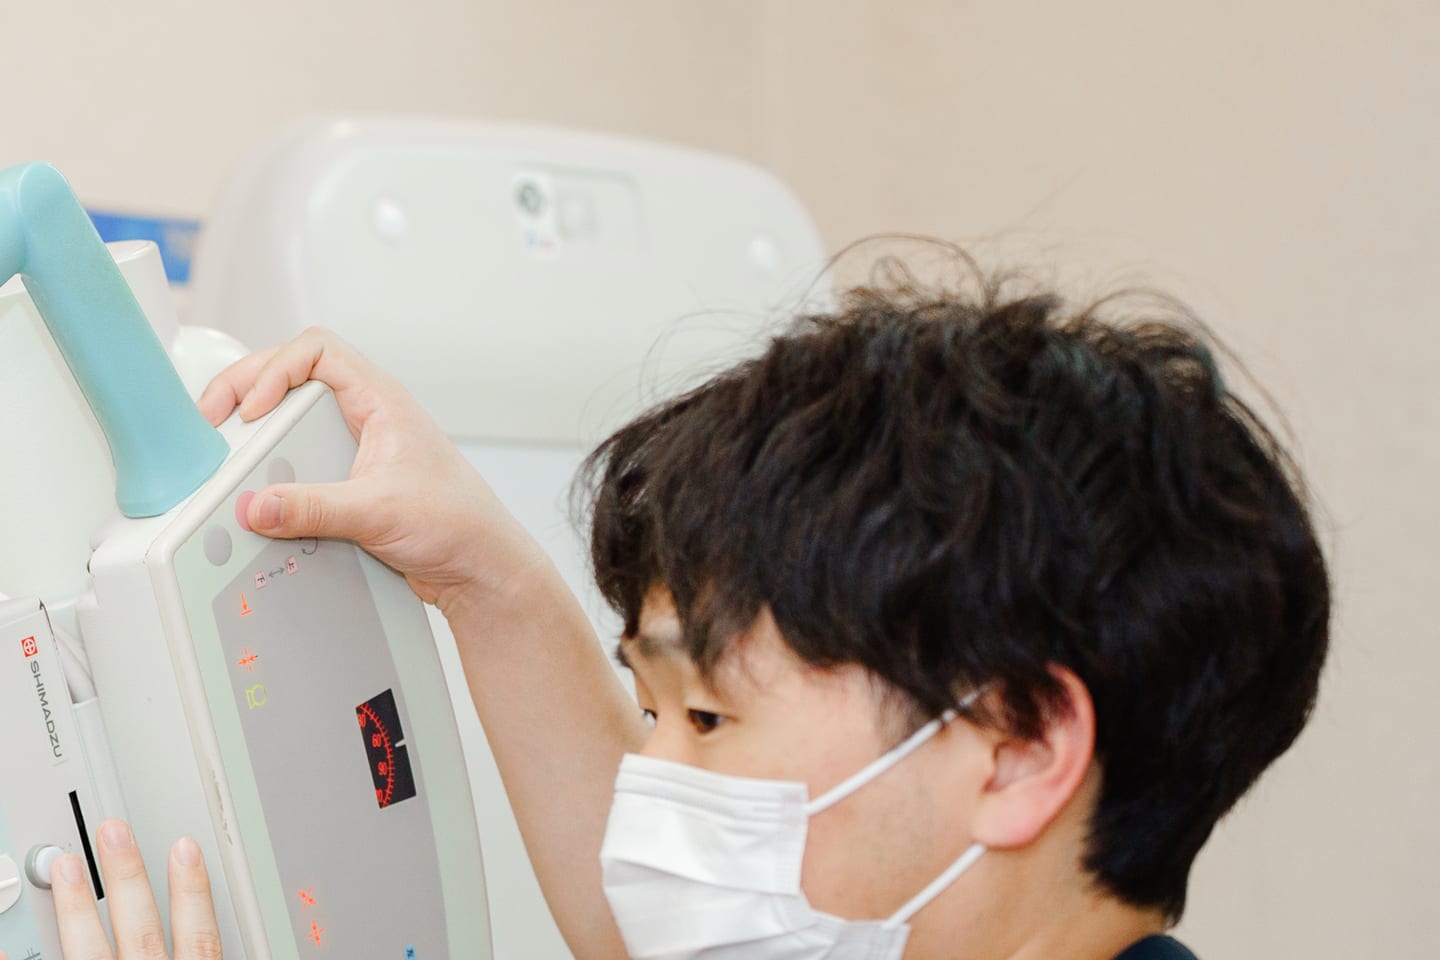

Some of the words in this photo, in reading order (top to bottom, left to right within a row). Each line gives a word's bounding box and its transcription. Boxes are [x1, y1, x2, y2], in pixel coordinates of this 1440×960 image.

[30, 660, 63, 758] SHIMADZU
[372, 733, 382, 748] 60
[377, 761, 388, 776] 90
